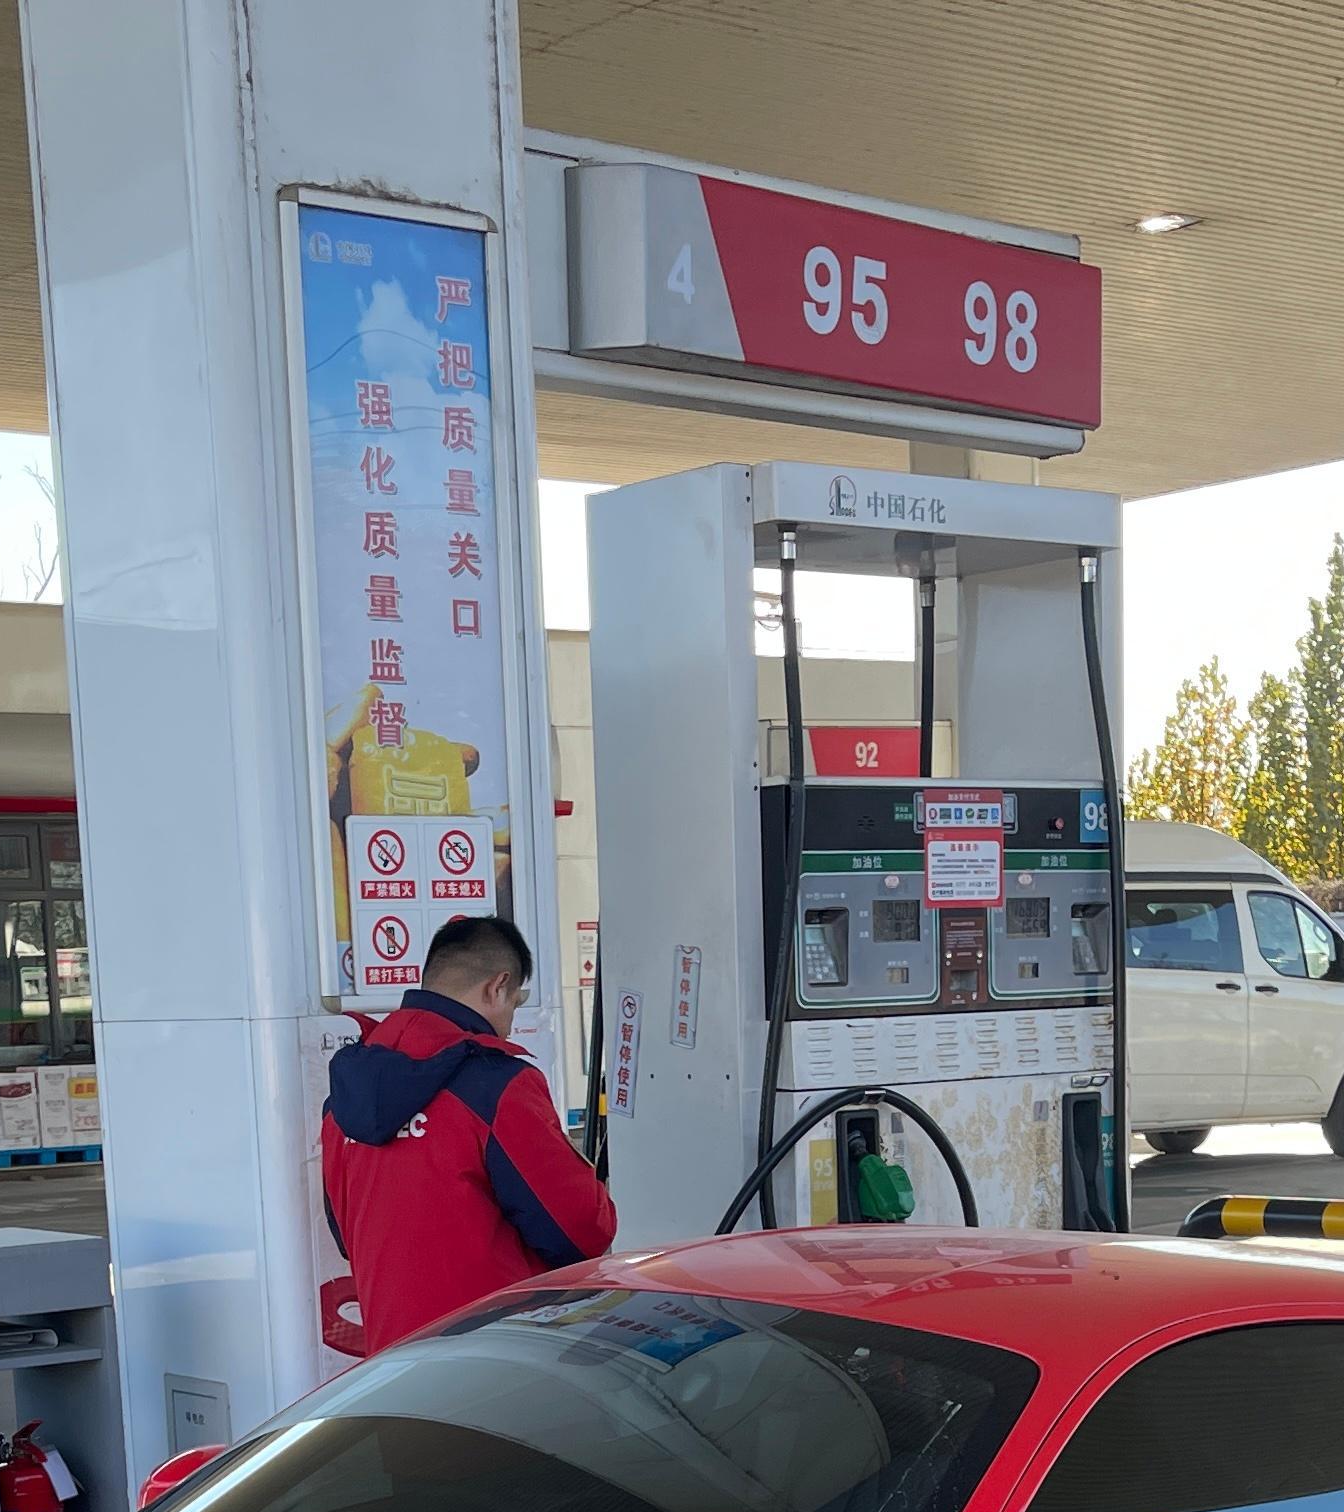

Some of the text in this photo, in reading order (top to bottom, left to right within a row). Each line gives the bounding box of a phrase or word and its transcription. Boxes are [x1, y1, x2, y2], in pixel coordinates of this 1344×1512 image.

[666, 243, 696, 306] 4
[801, 245, 1039, 374] 95 98
[434, 274, 483, 639] 严把质量关口
[867, 490, 947, 525] 中国石化
[354, 379, 408, 749] 强化质量监督
[854, 741, 880, 770] 92
[1084, 801, 1109, 832] 98
[362, 882, 414, 899] 严禁烟火
[368, 967, 419, 984] 禁打手机
[676, 954, 695, 1042] 暂停使用
[615, 1021, 635, 1109] 暂停使用
[813, 1158, 833, 1178] 95
